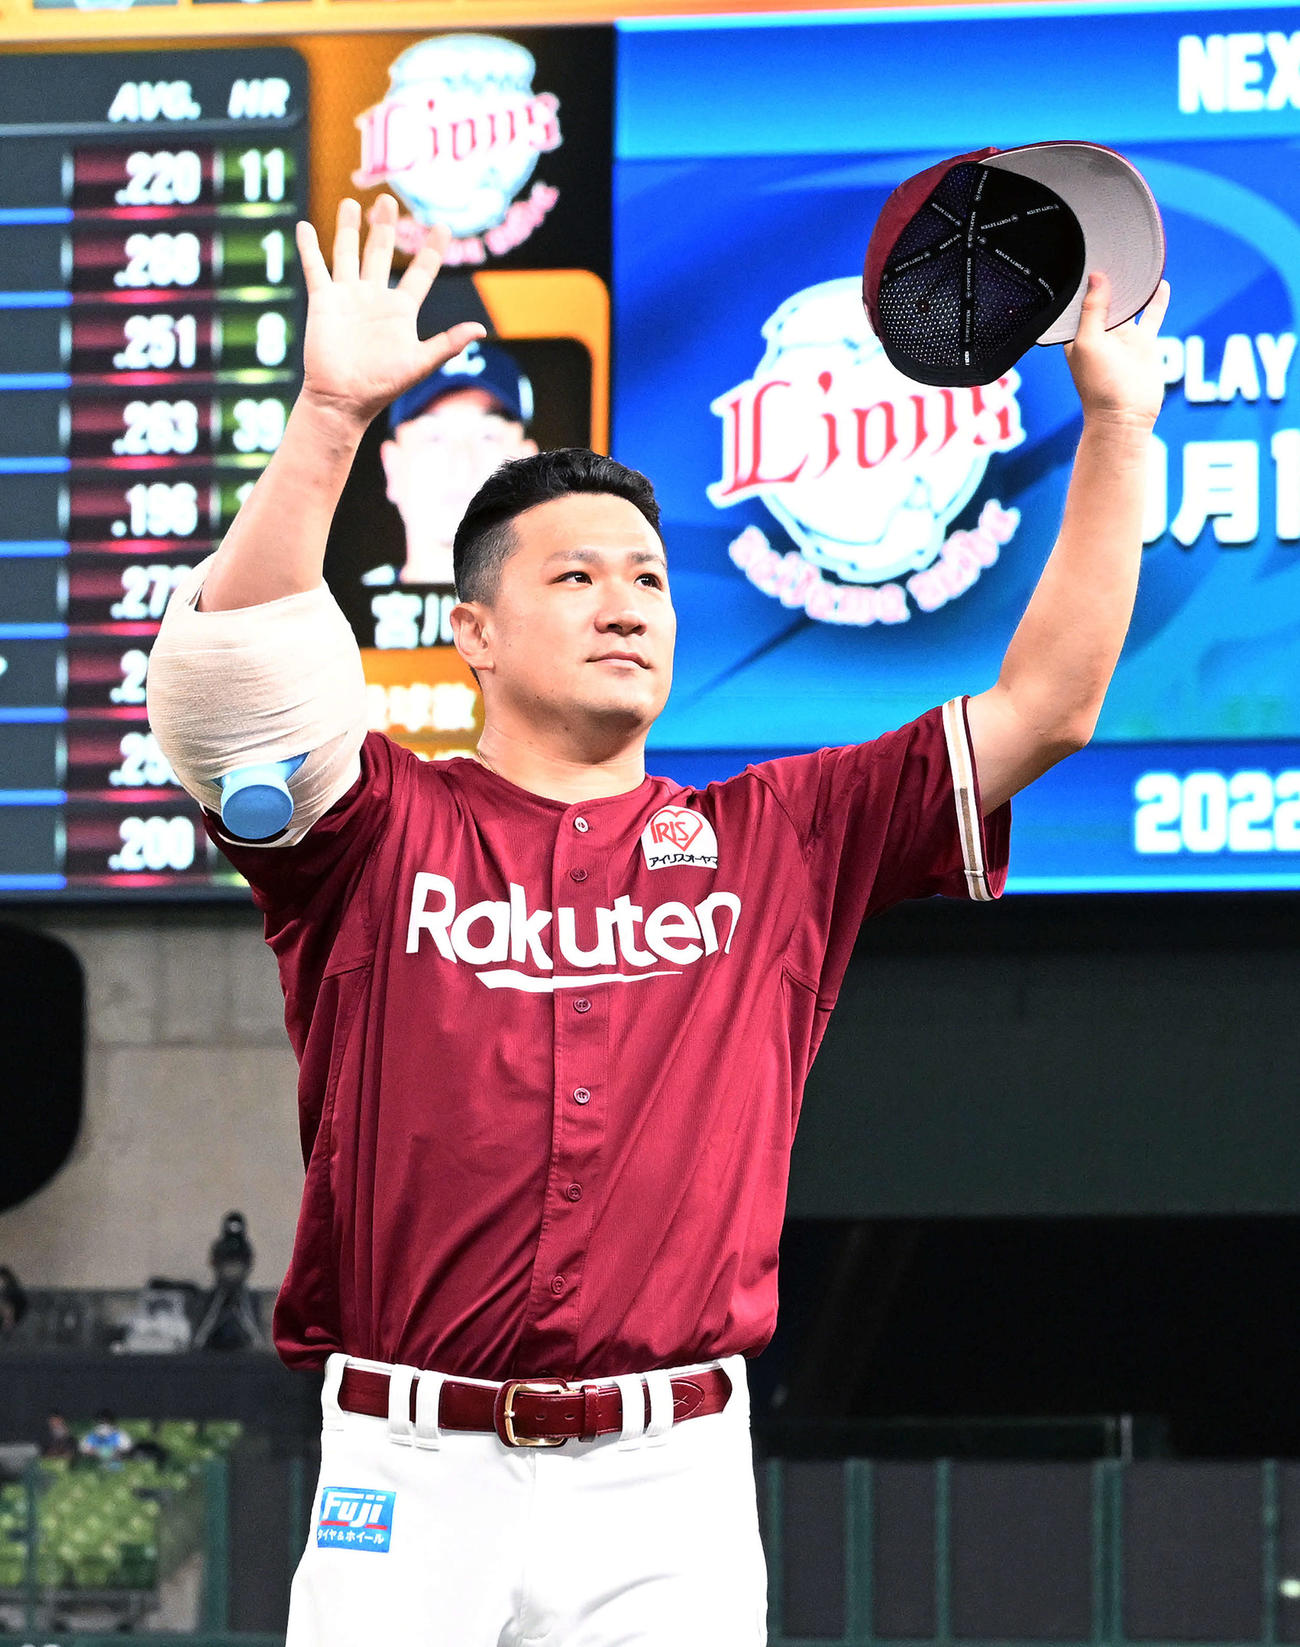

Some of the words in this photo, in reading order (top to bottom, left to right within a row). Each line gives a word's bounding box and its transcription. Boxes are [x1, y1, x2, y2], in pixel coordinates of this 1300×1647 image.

[227, 77, 290, 119] HR
[352, 92, 562, 188] Lions
[116, 151, 201, 204] .220
[240, 149, 285, 201] 11
[262, 231, 284, 282] 1
[114, 315, 196, 368] .251
[1156, 332, 1297, 402] PLAY
[720, 370, 1010, 496] Lions
[109, 816, 195, 869] .200
[650, 820, 689, 844] IRIS
[405, 871, 742, 970] Rakuten
[322, 1491, 387, 1527] Fuji
